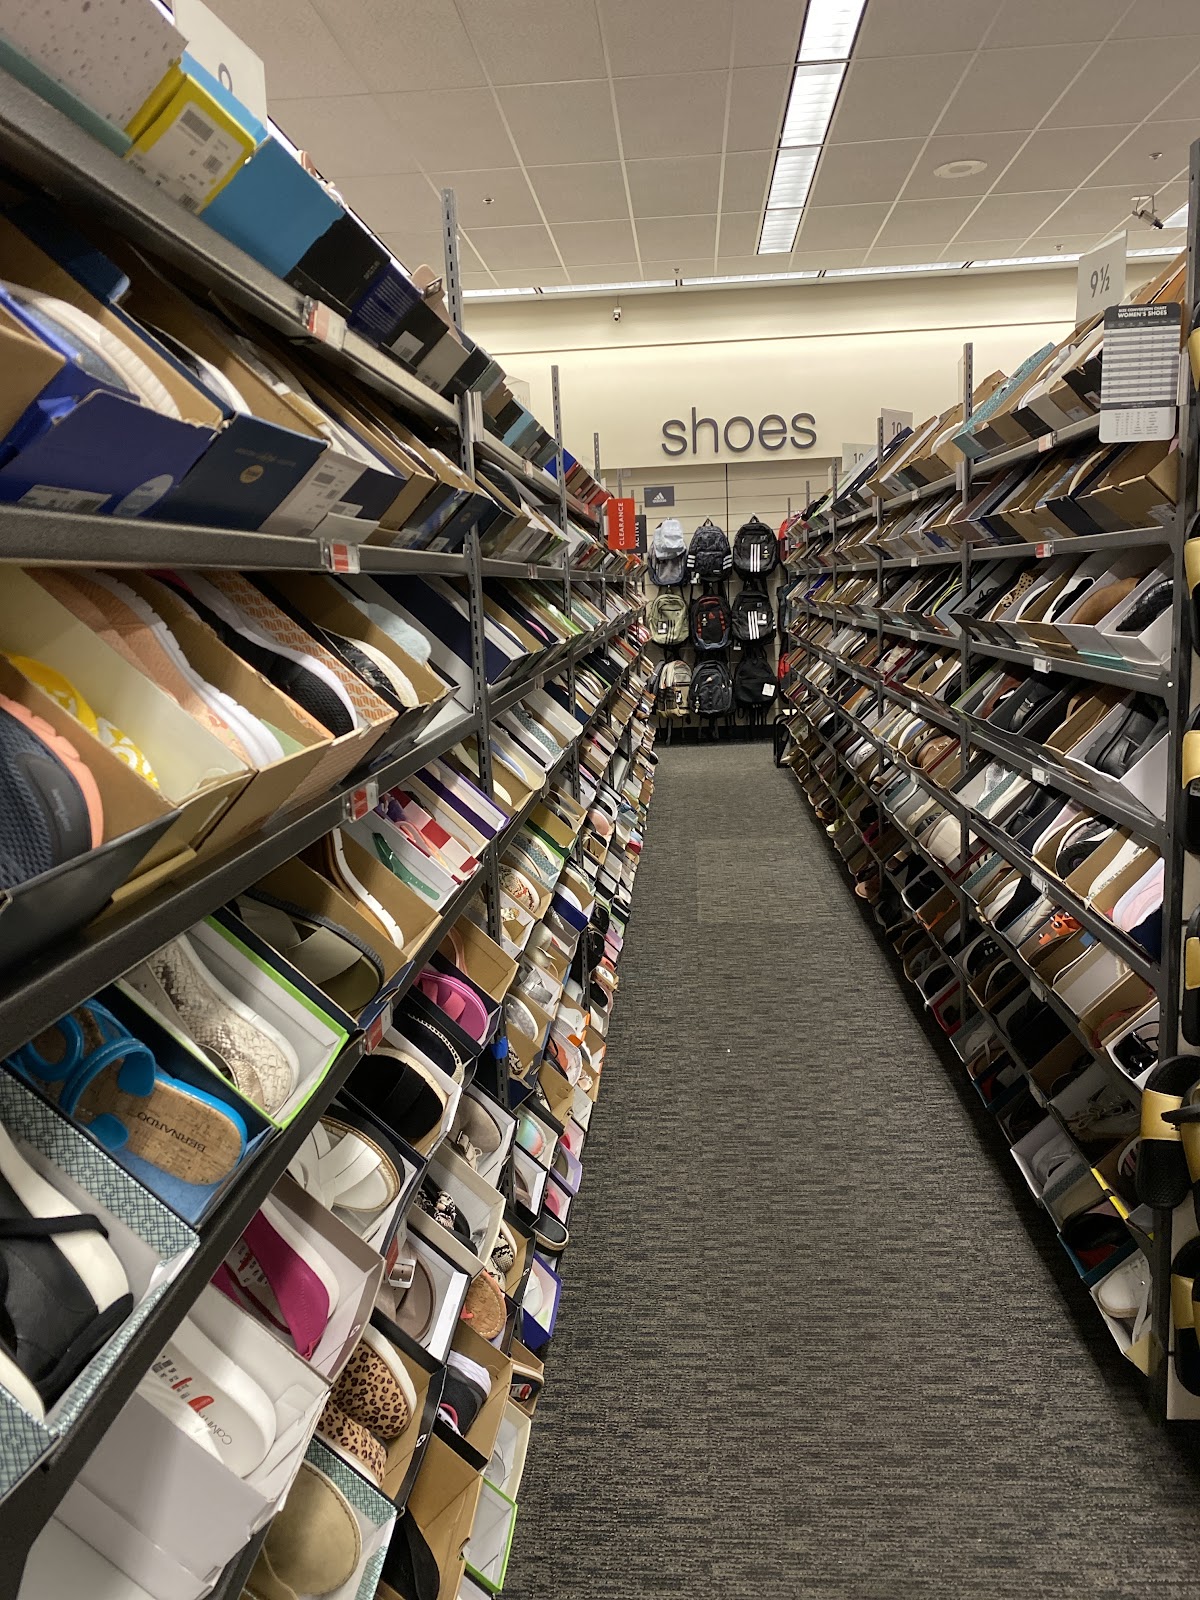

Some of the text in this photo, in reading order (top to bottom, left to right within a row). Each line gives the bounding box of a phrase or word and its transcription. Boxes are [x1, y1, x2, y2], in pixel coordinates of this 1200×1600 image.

[661, 406, 817, 456] shoes
[617, 502, 625, 546] CLEARANCE
[137, 1111, 206, 1153] BERNARDO
